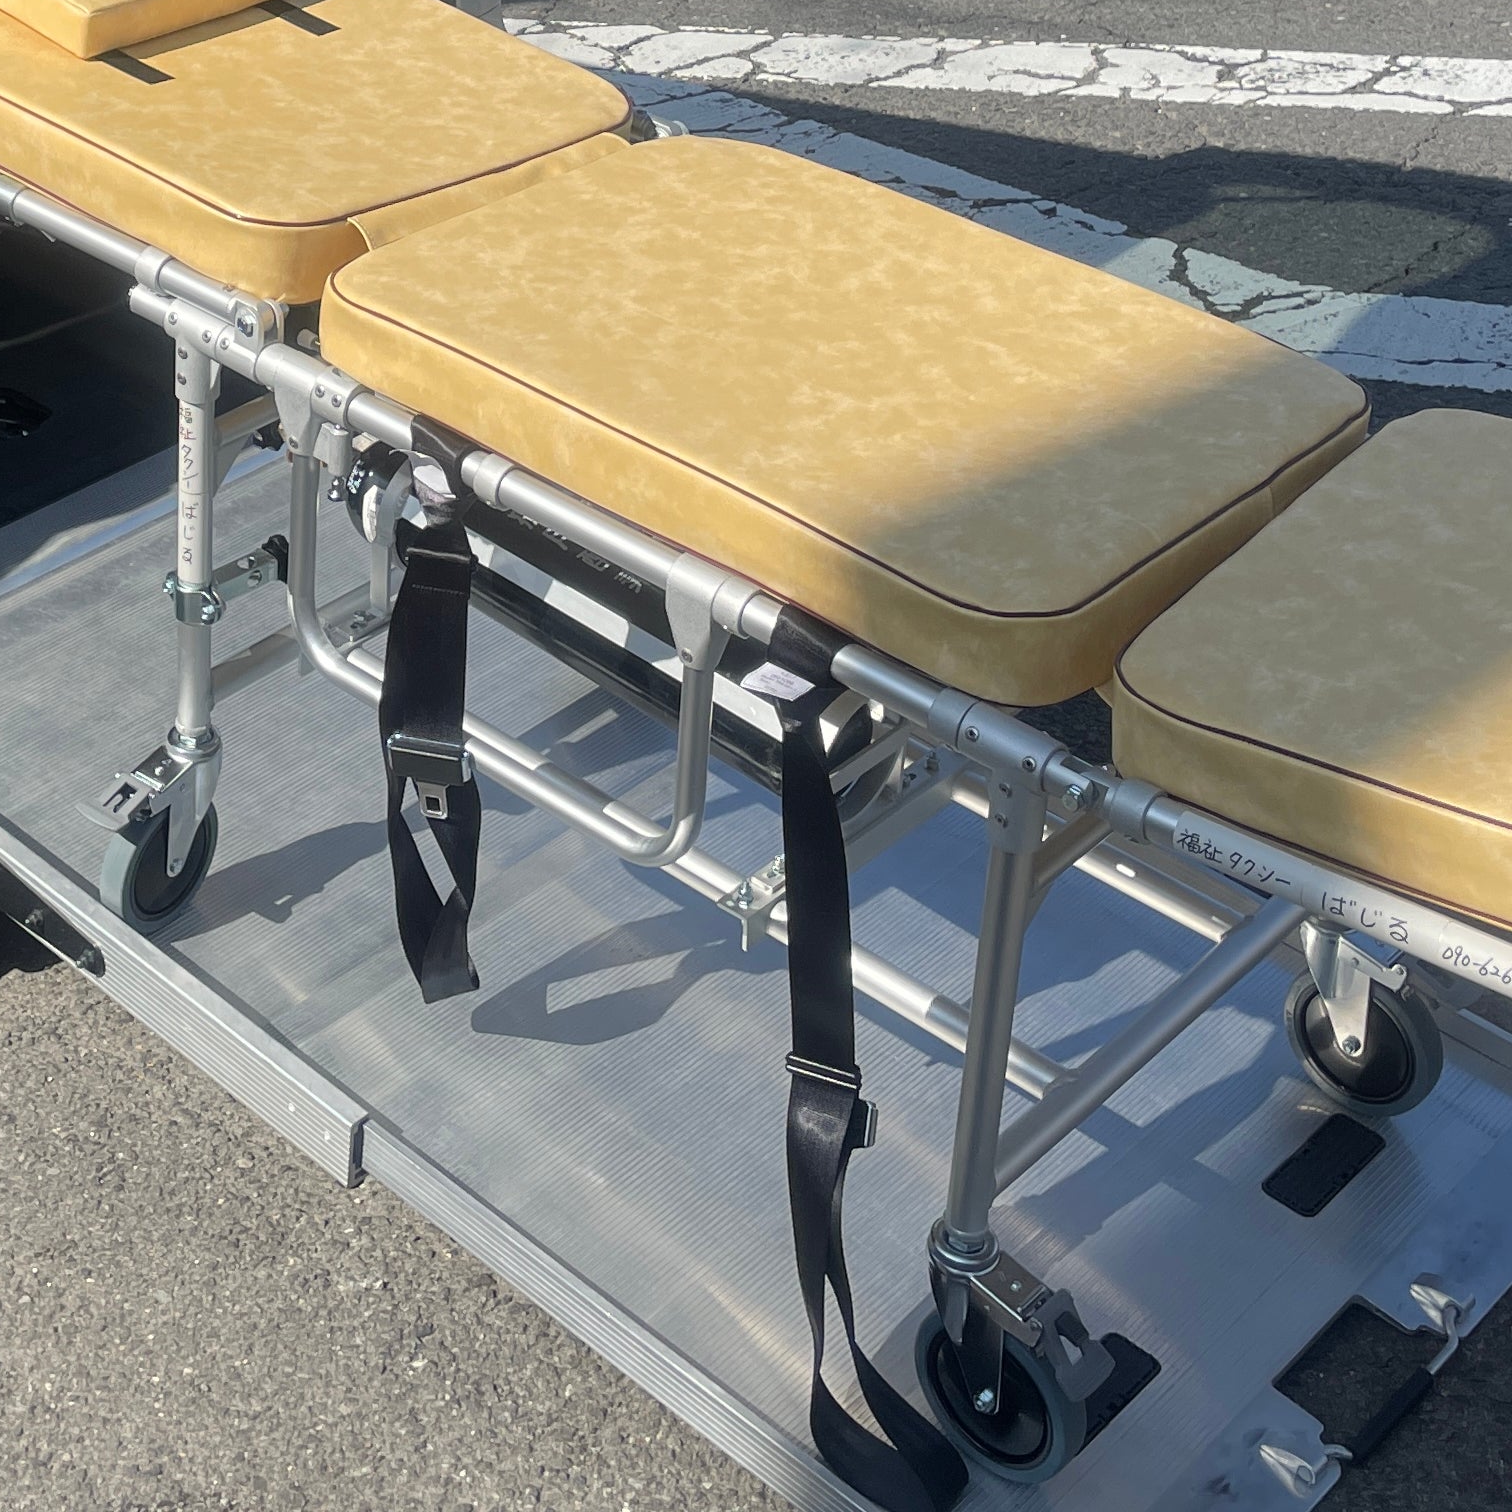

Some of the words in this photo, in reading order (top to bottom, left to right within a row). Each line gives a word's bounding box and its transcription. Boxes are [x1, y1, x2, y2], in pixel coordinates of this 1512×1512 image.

[1177, 829, 1291, 887] 福祉タクシー
[1321, 891, 1410, 945] ばじる
